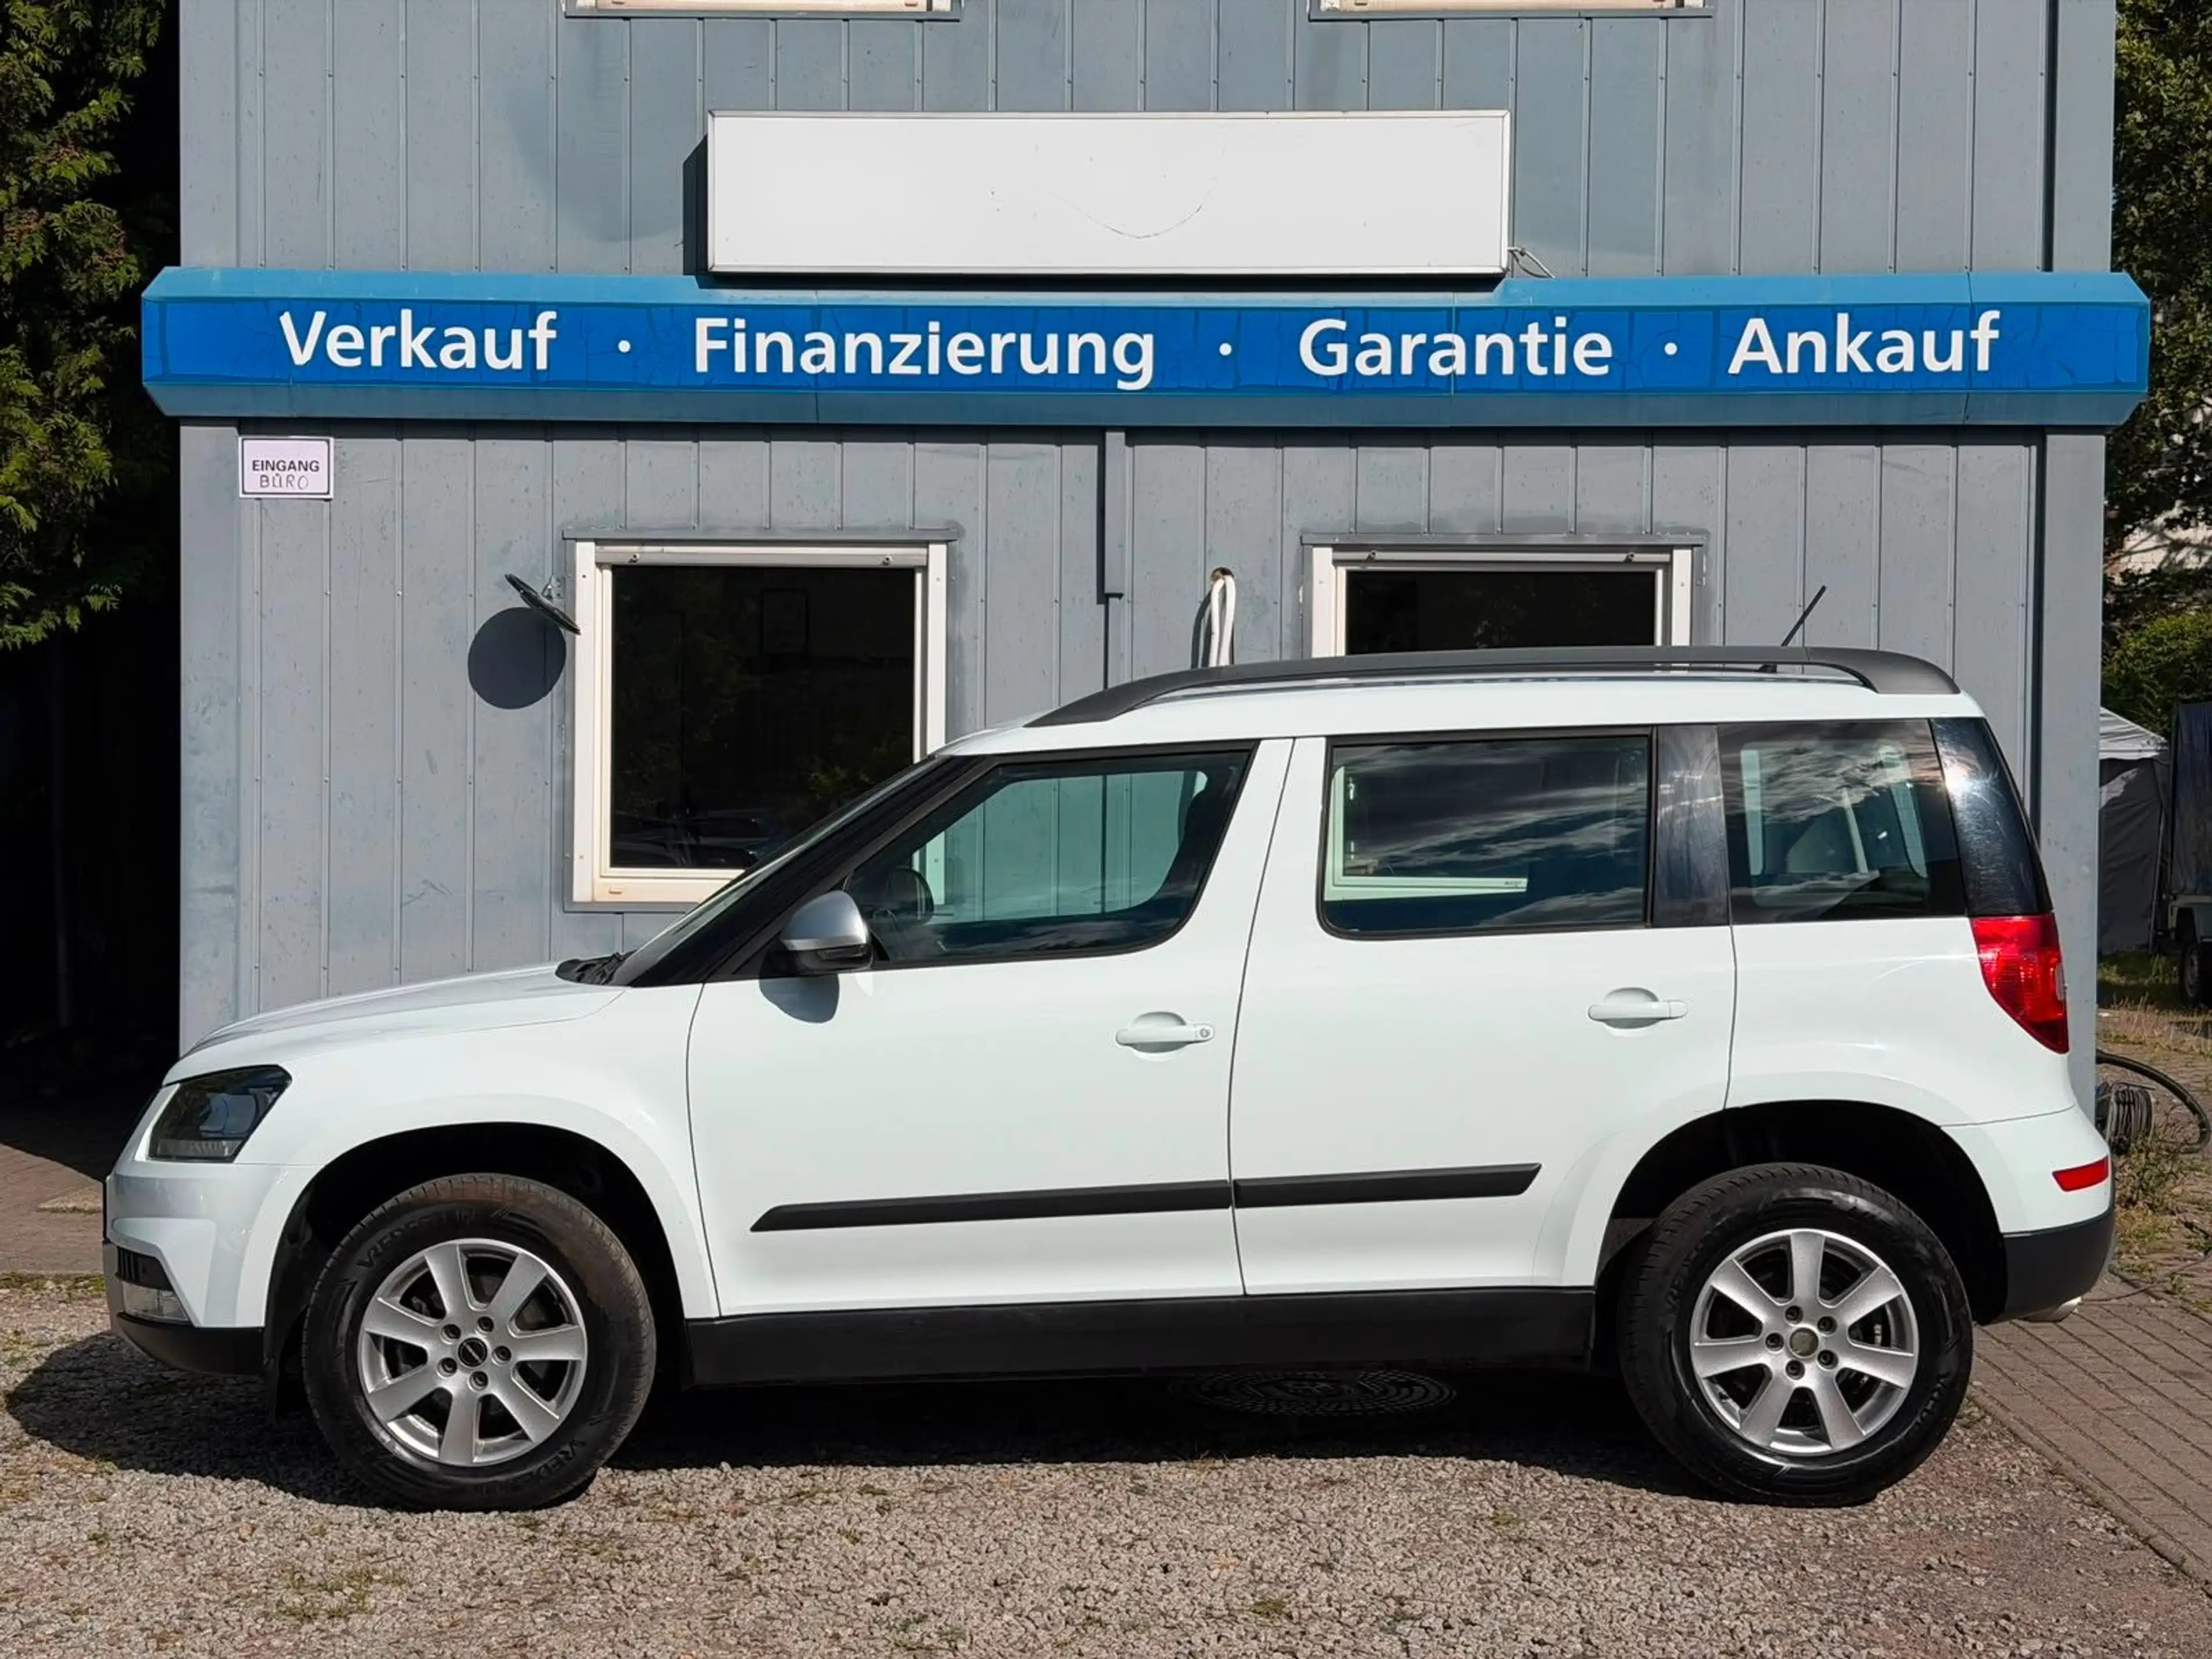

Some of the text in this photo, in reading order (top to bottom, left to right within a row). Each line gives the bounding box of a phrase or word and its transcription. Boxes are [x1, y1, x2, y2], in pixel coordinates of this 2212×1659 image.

[279, 309, 2001, 391] Verkauf Finanzierung Garantie Ankauf
[252, 460, 320, 472] EINGANG
[260, 473, 309, 490] BÜRO
